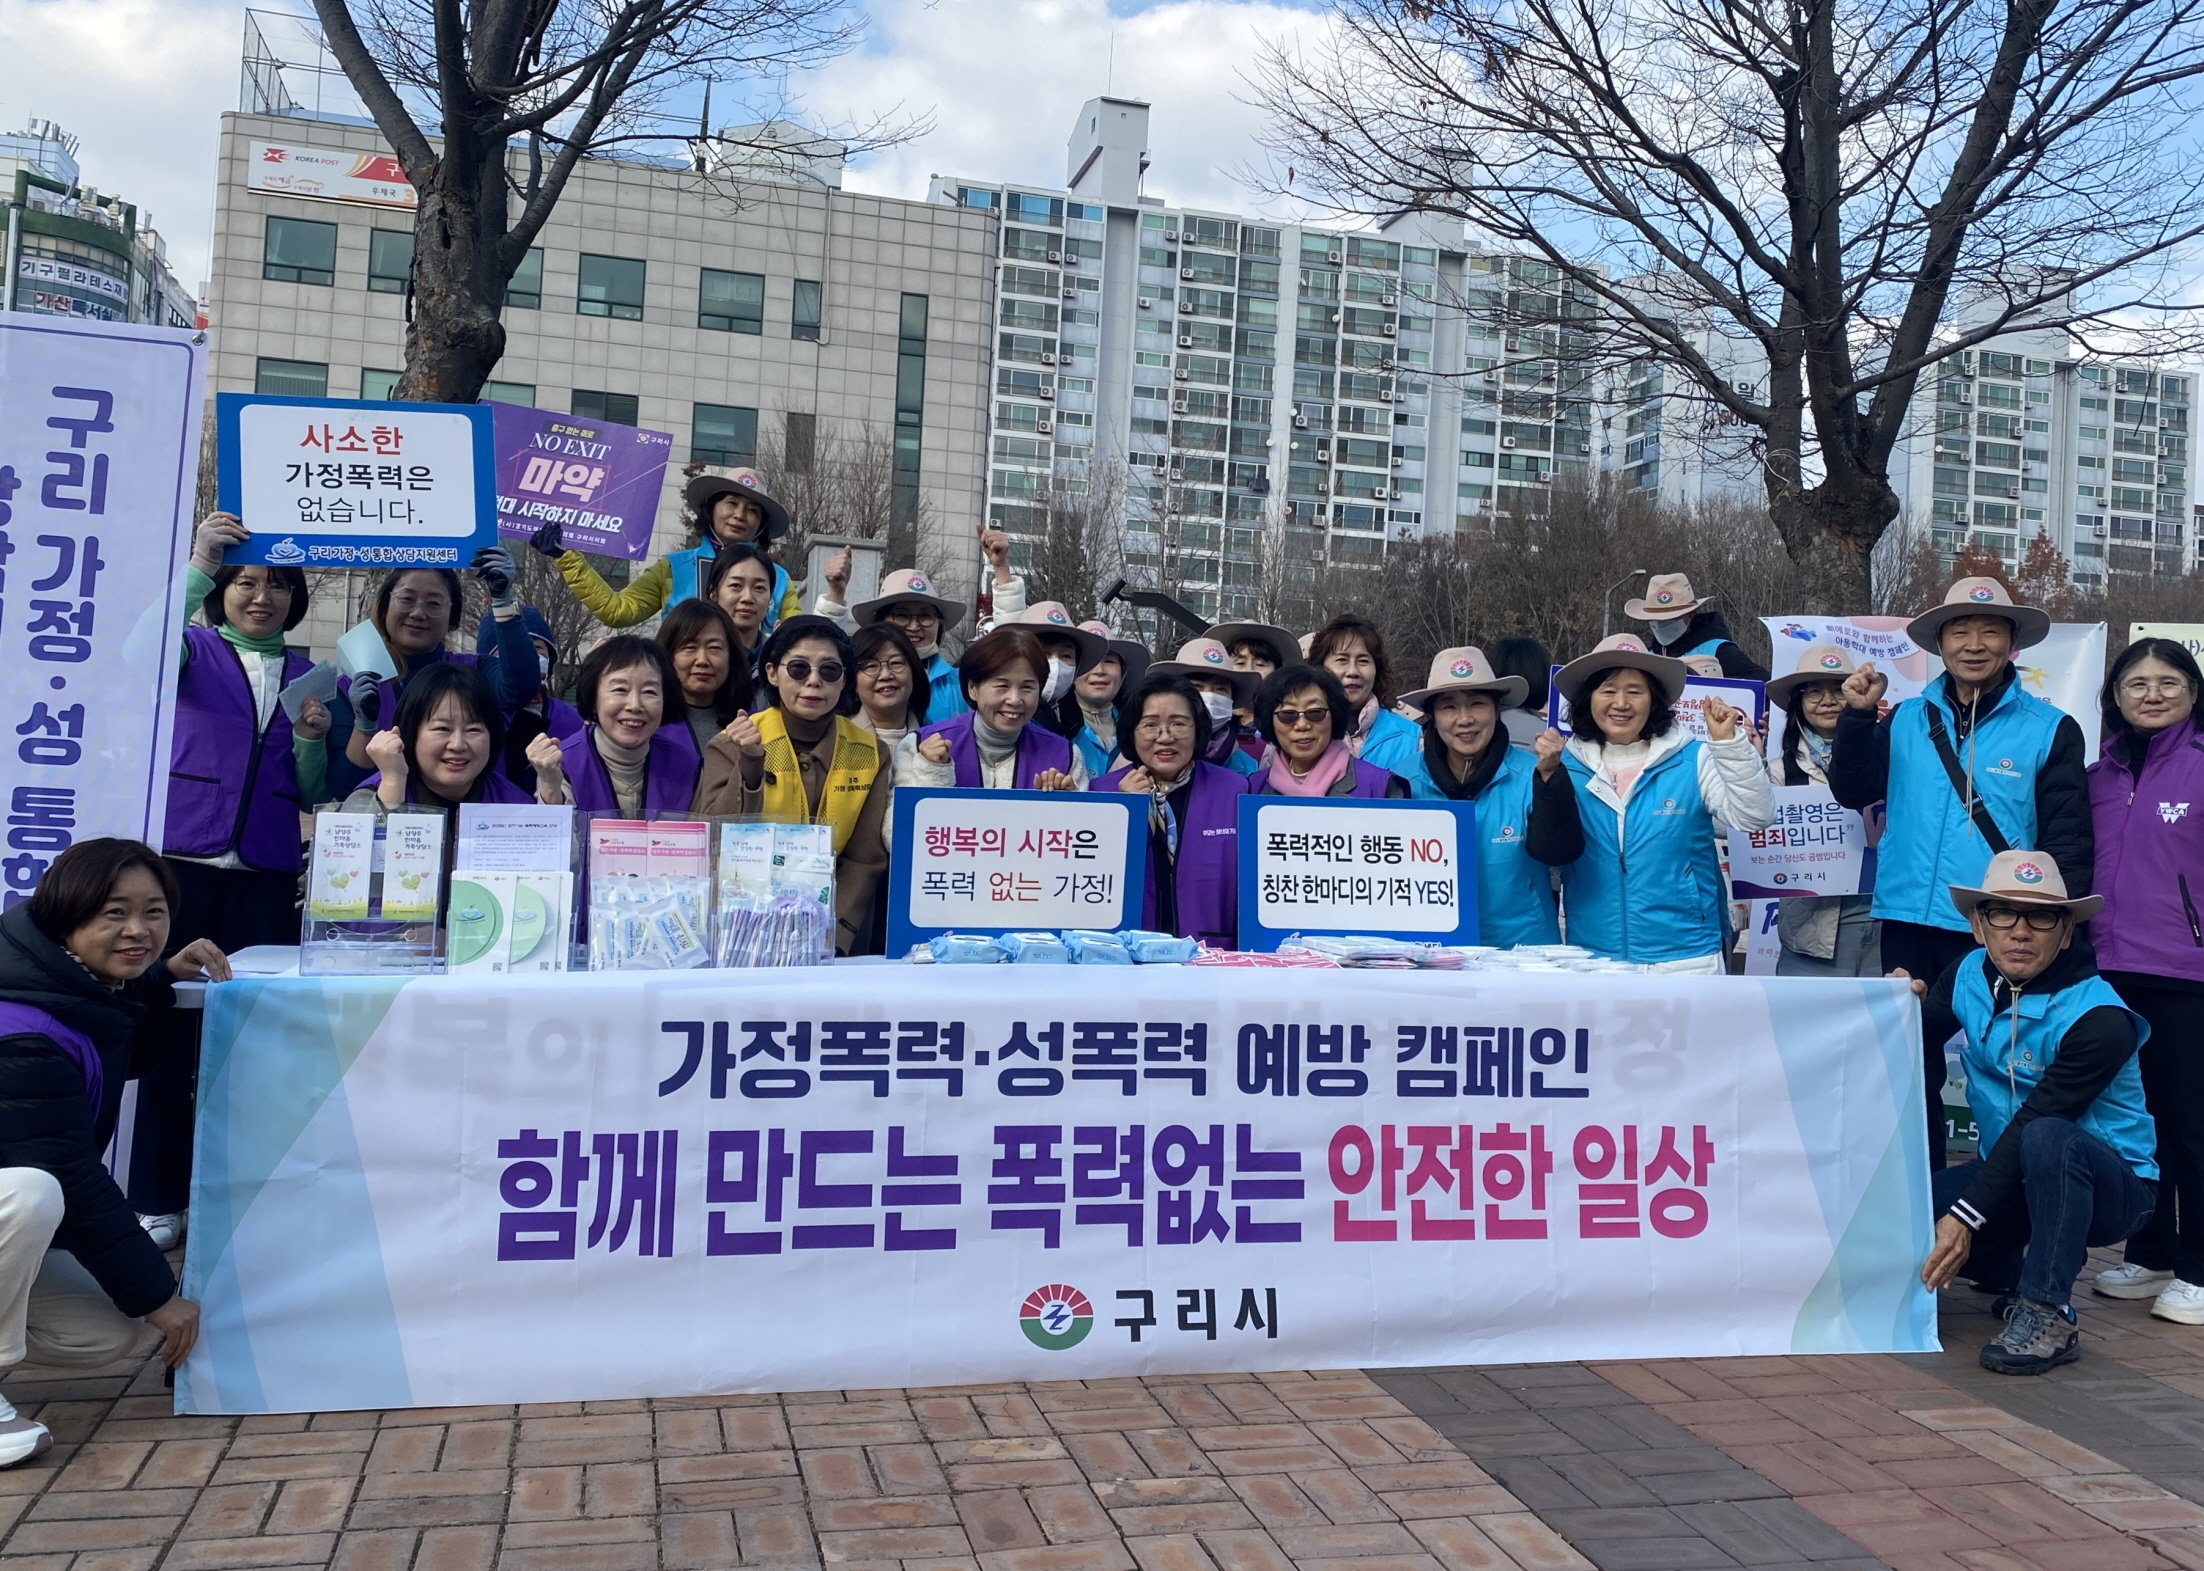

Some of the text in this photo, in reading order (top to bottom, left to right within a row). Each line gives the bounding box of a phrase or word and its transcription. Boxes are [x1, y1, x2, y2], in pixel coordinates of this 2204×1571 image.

[295, 155, 319, 164] KOREA
[372, 187, 396, 197] 우체국
[41, 386, 114, 515] 구리
[300, 423, 404, 456] 사소한
[529, 432, 611, 460] NO EXIT
[285, 462, 434, 491] 가정폭력은
[518, 456, 606, 503] 마약
[297, 496, 424, 525] 없습니다.
[518, 500, 580, 526] 시작하지
[578, 511, 624, 534] 마세요
[1825, 624, 1894, 645] 삐에로와 함께하는
[1835, 636, 1911, 658] 아동학대 예방 캠페인
[924, 826, 1099, 859] 행복의 시작은
[1266, 832, 1449, 867] 폭력적인 행동 NO,
[1751, 851, 1846, 864] 보는 순간 당신도 공범입니다
[921, 871, 1114, 904] 폭력 없는 가정!
[1262, 873, 1454, 908] 칭찬 한마디의 기적 YES!
[1791, 872, 1826, 883] 구리시
[659, 1020, 1208, 1099] 가정폭력·성폭력
[1236, 1022, 1371, 1098] 예방
[1396, 1025, 1590, 1098] 캠페인
[497, 1122, 1716, 1262] 함께 만드는 폭력없는 안전한 일상
[1114, 1287, 1279, 1342] 구리시
